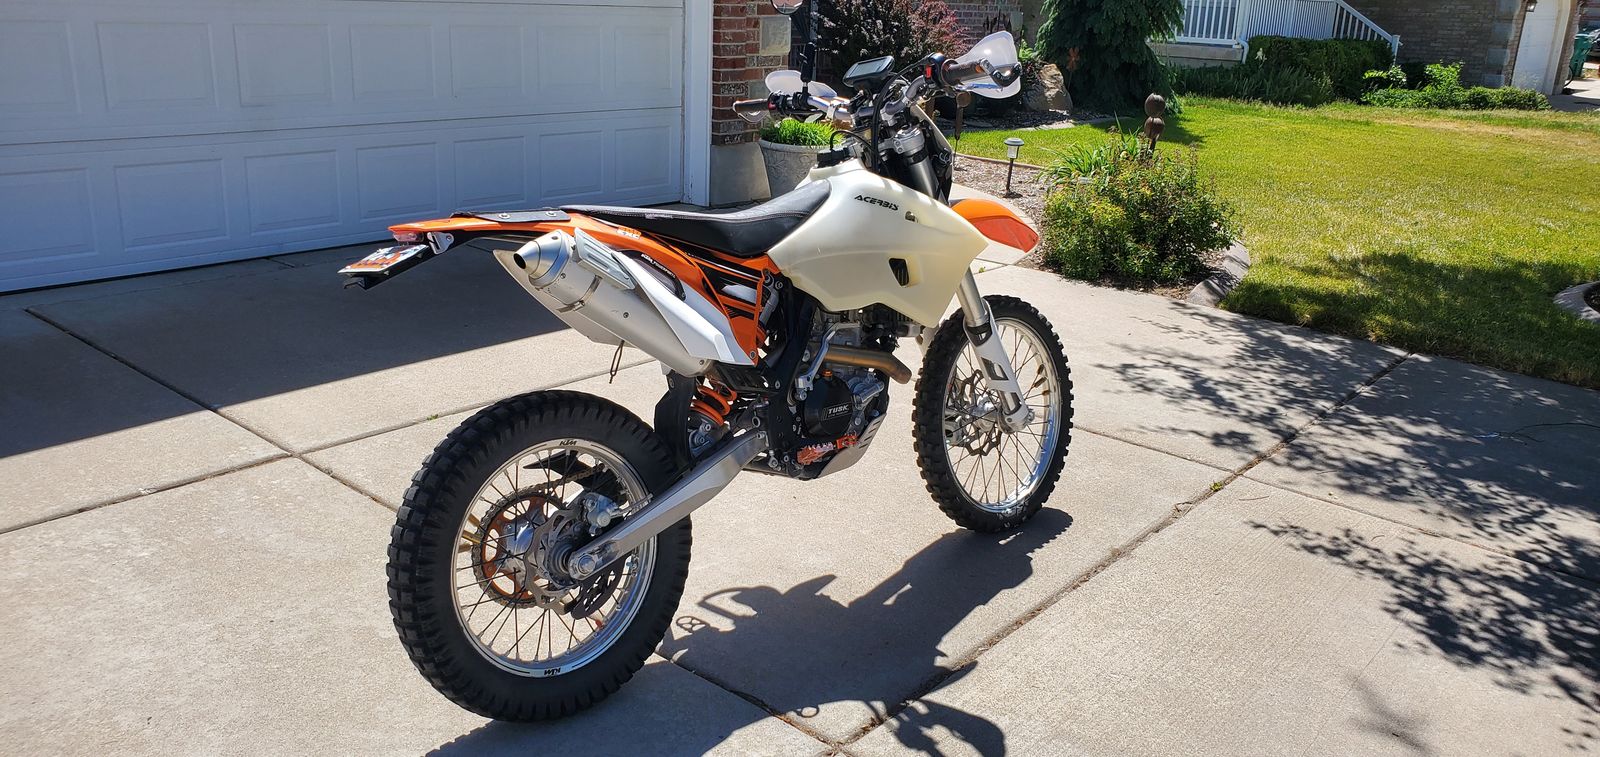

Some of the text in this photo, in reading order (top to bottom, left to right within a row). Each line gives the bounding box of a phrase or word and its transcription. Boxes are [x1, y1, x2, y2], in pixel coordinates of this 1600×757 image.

[854, 194, 899, 211] ACERBIS
[828, 404, 849, 415] TUSK
[543, 667, 561, 676] KTM
